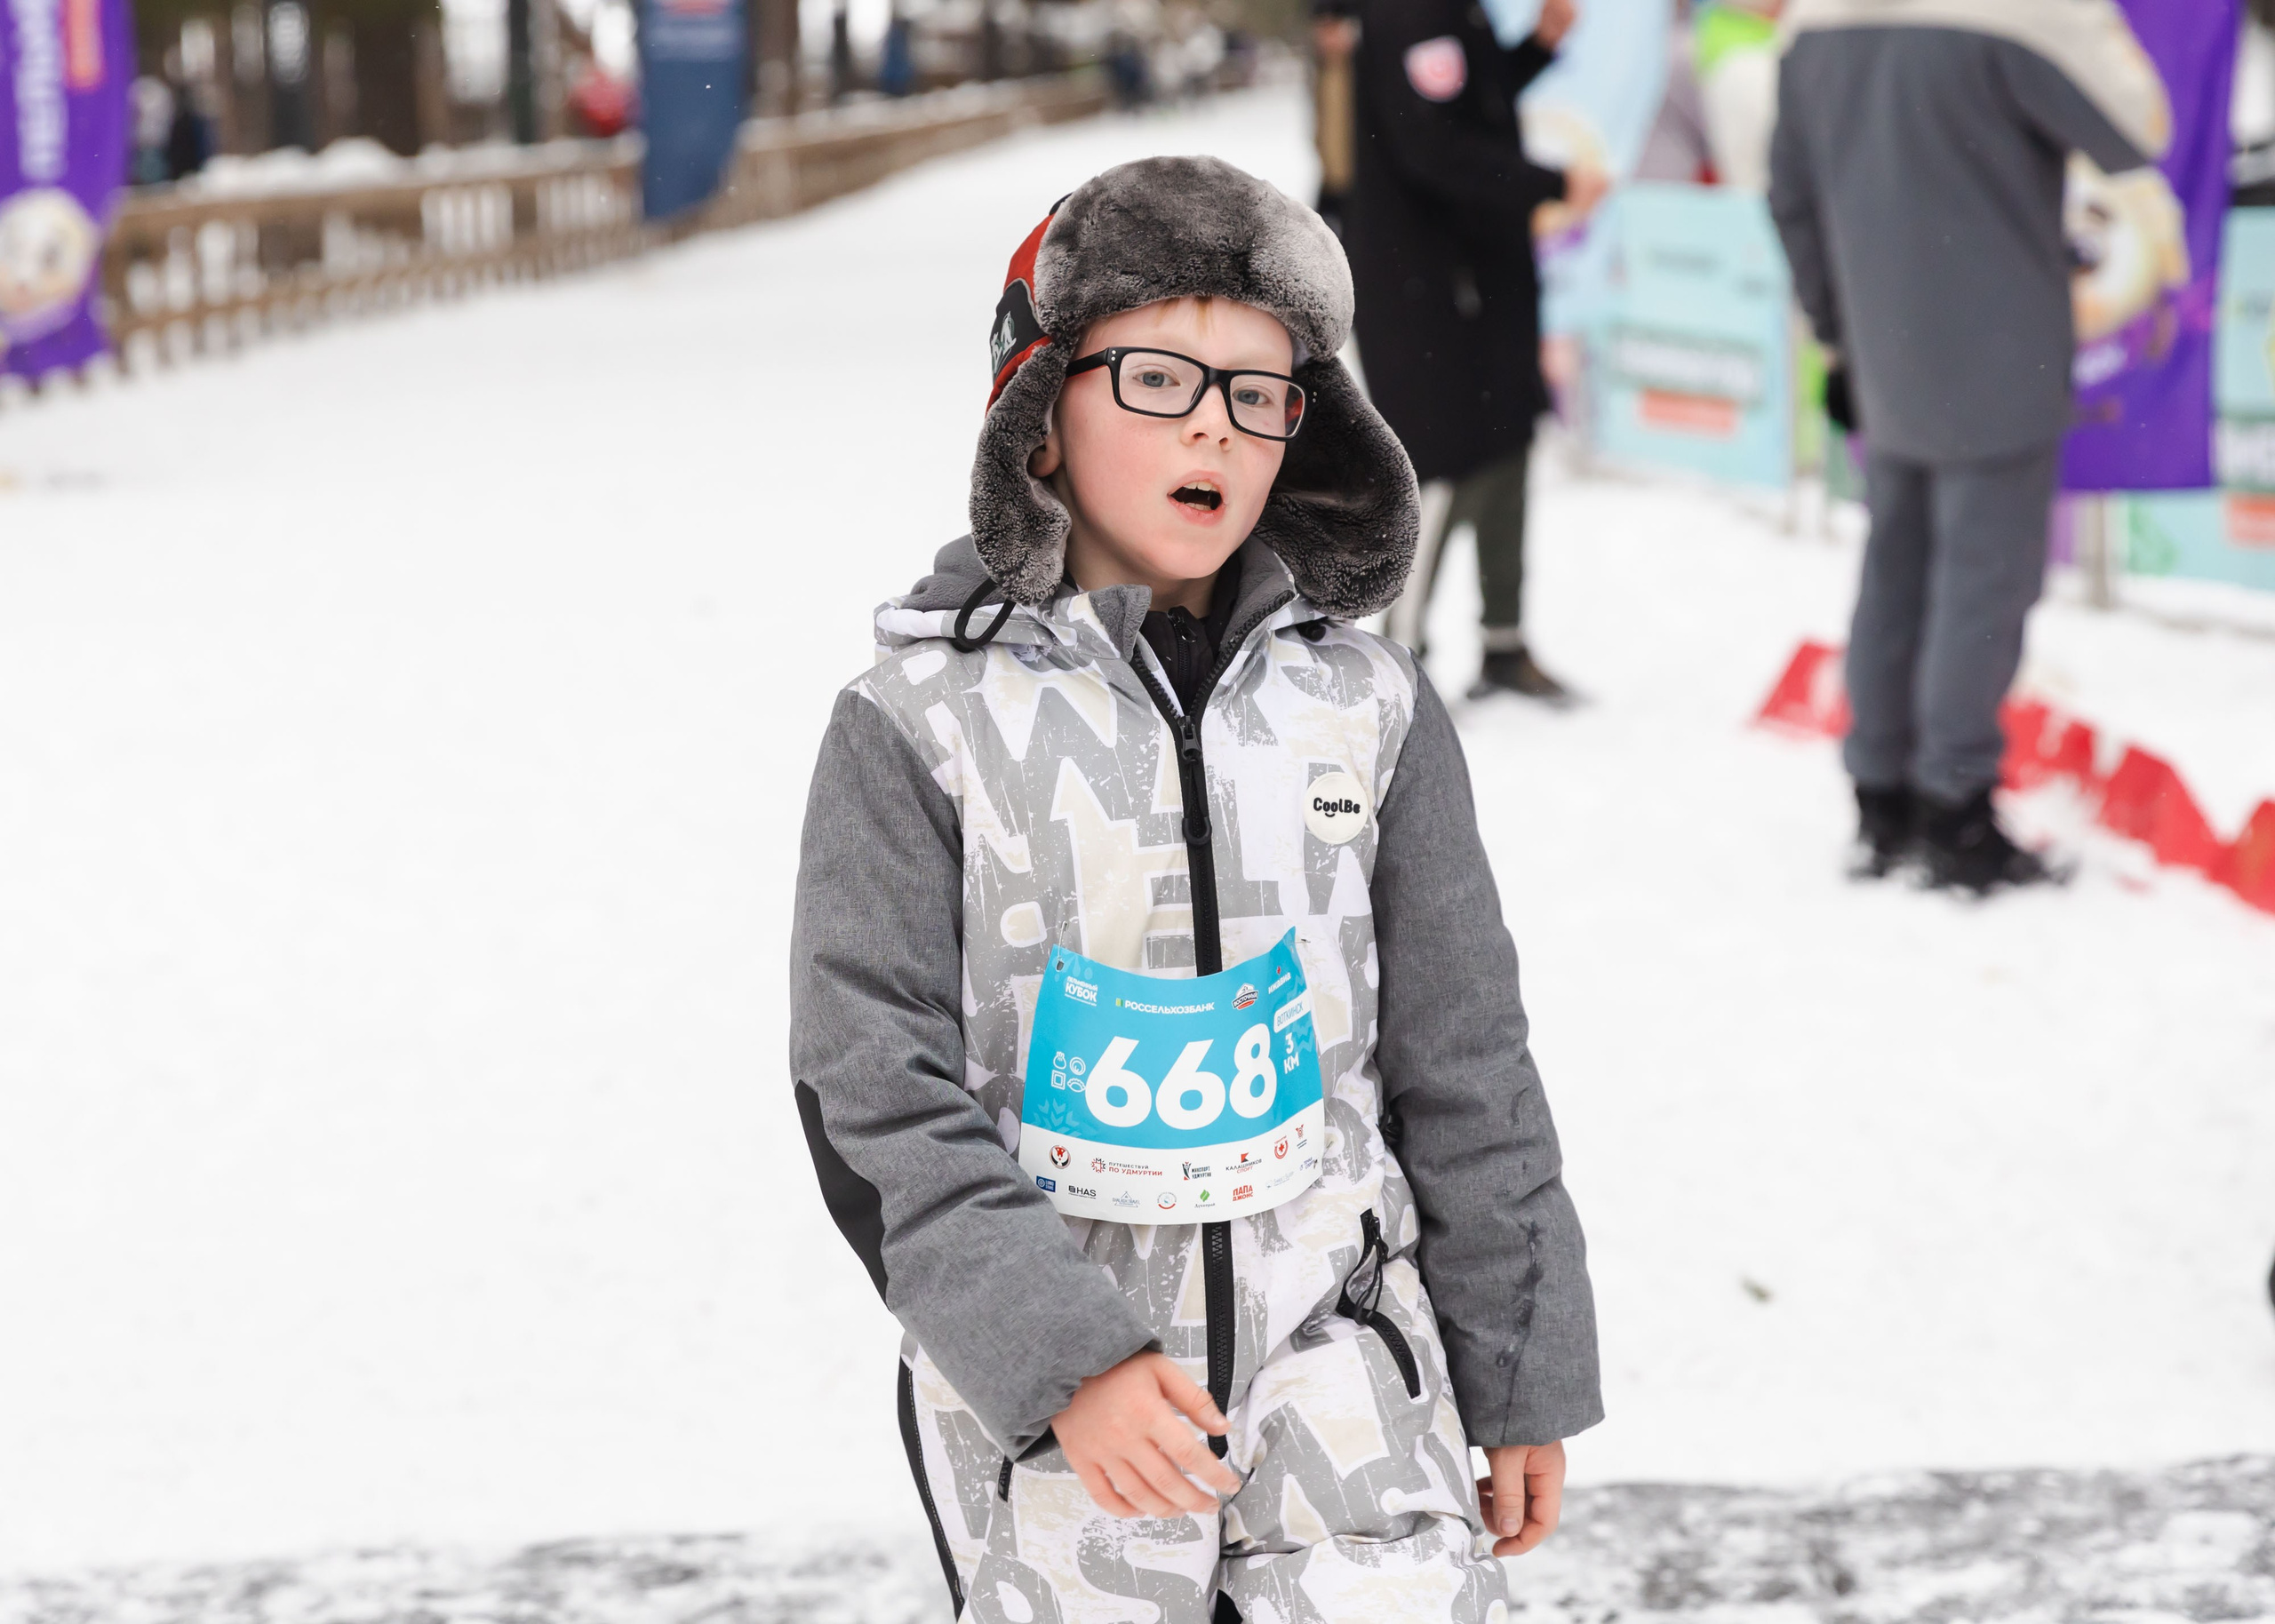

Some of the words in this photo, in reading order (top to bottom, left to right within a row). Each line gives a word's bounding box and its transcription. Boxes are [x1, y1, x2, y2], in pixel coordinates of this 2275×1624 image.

[1313, 797, 1361, 815] CoolBe
[1066, 983, 1098, 1002] КУБОК
[1124, 999, 1215, 1014] РОССЕЛЬХОЗБАНК
[1277, 1002, 1304, 1026] ВОТКИНСК
[1285, 1032, 1294, 1055] 3
[1283, 1052, 1299, 1074] КМ
[1085, 1023, 1277, 1130] 668
[1108, 1161, 1149, 1170] ПУТЕШЕСТВУЙ
[1225, 1158, 1262, 1171] КАЛАШНИКОВ
[1076, 1187, 1097, 1198] HAS
[1232, 1192, 1254, 1202] ДЖОНС
[1233, 1185, 1253, 1196] ПАПА
